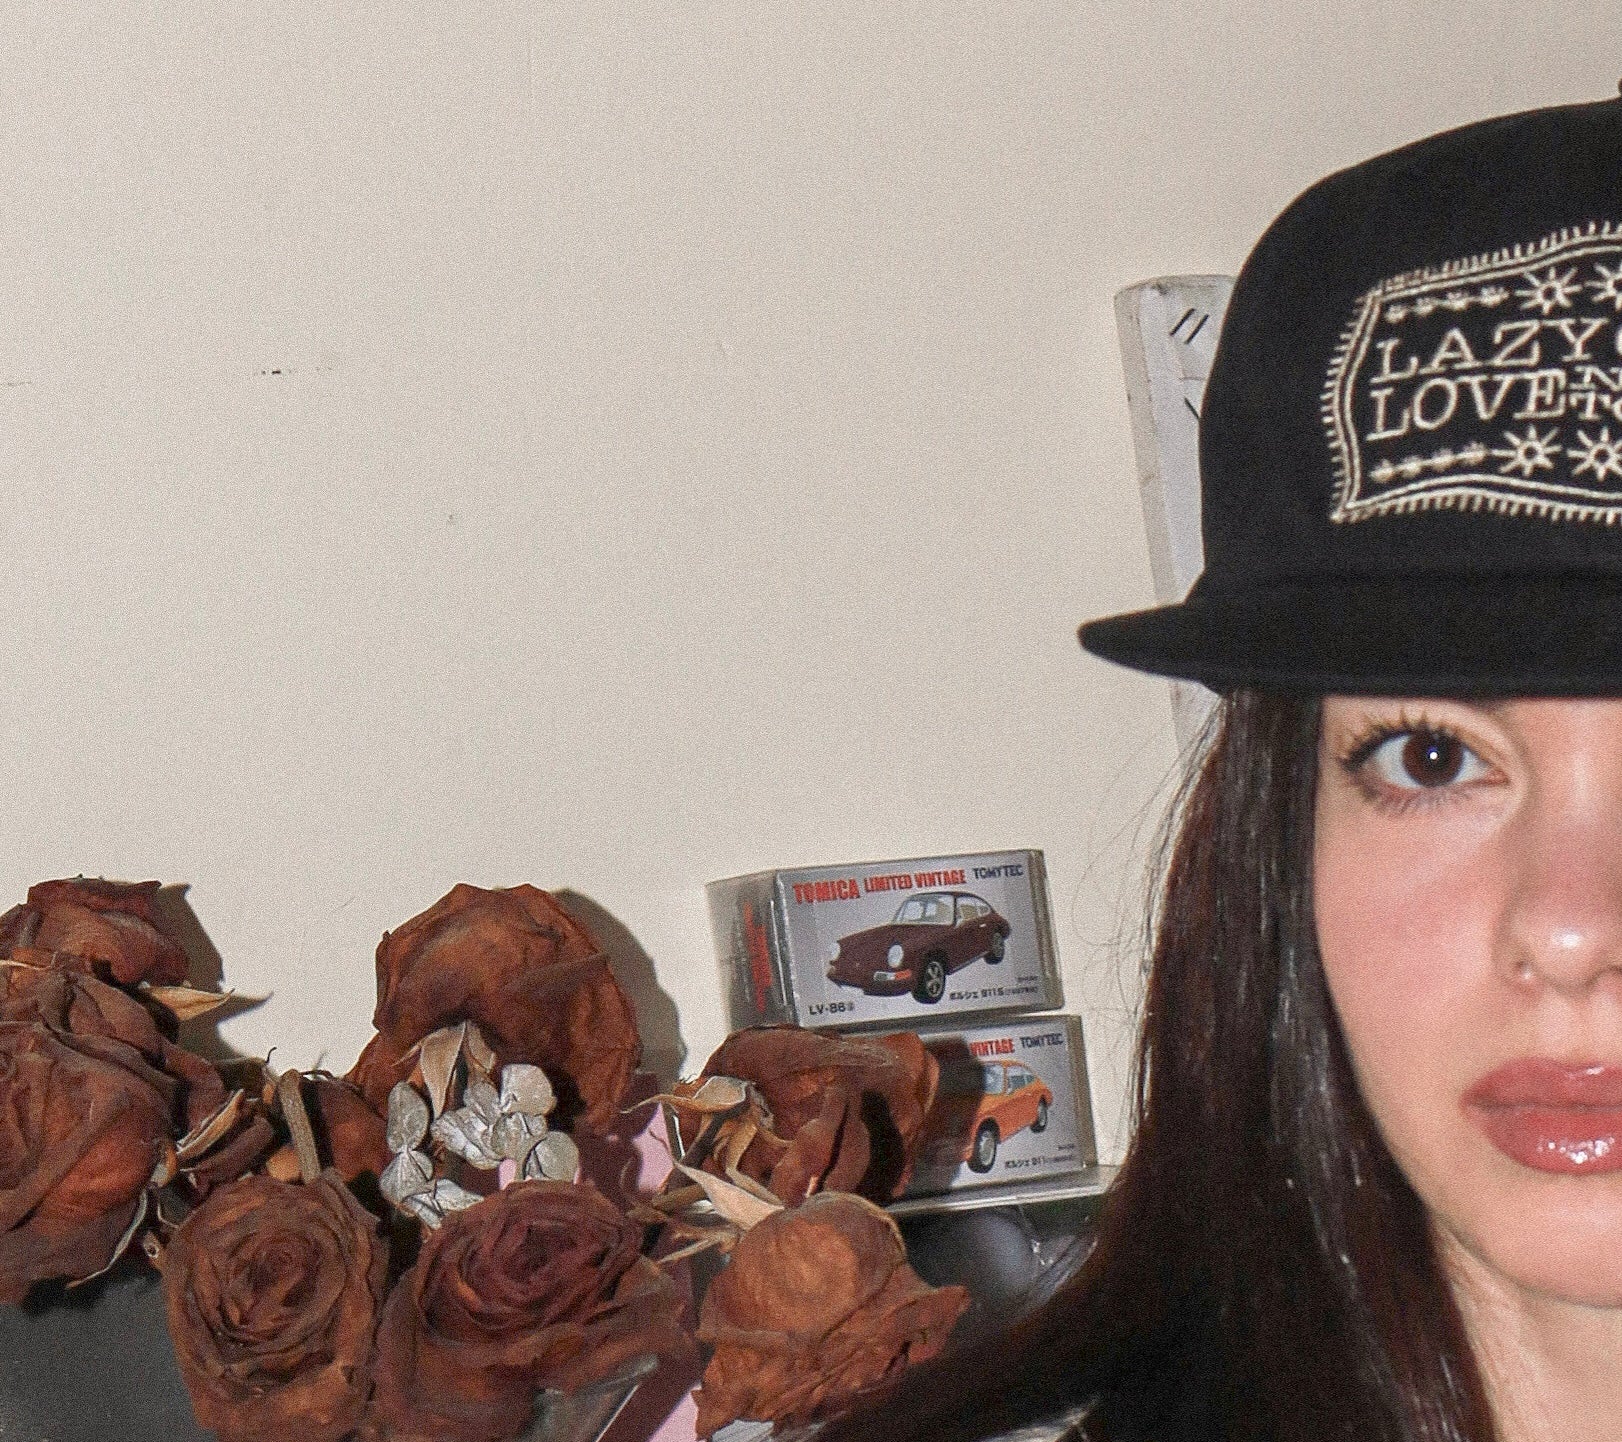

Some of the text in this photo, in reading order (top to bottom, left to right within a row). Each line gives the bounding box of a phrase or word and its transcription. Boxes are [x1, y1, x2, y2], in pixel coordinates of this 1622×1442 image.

[1365, 367, 1567, 441] LOVE
[792, 864, 1024, 905] TOMICA LIMITED VINTAGE TOMYTEC
[969, 1032, 1064, 1057] VINTAGE TOMYTEC
